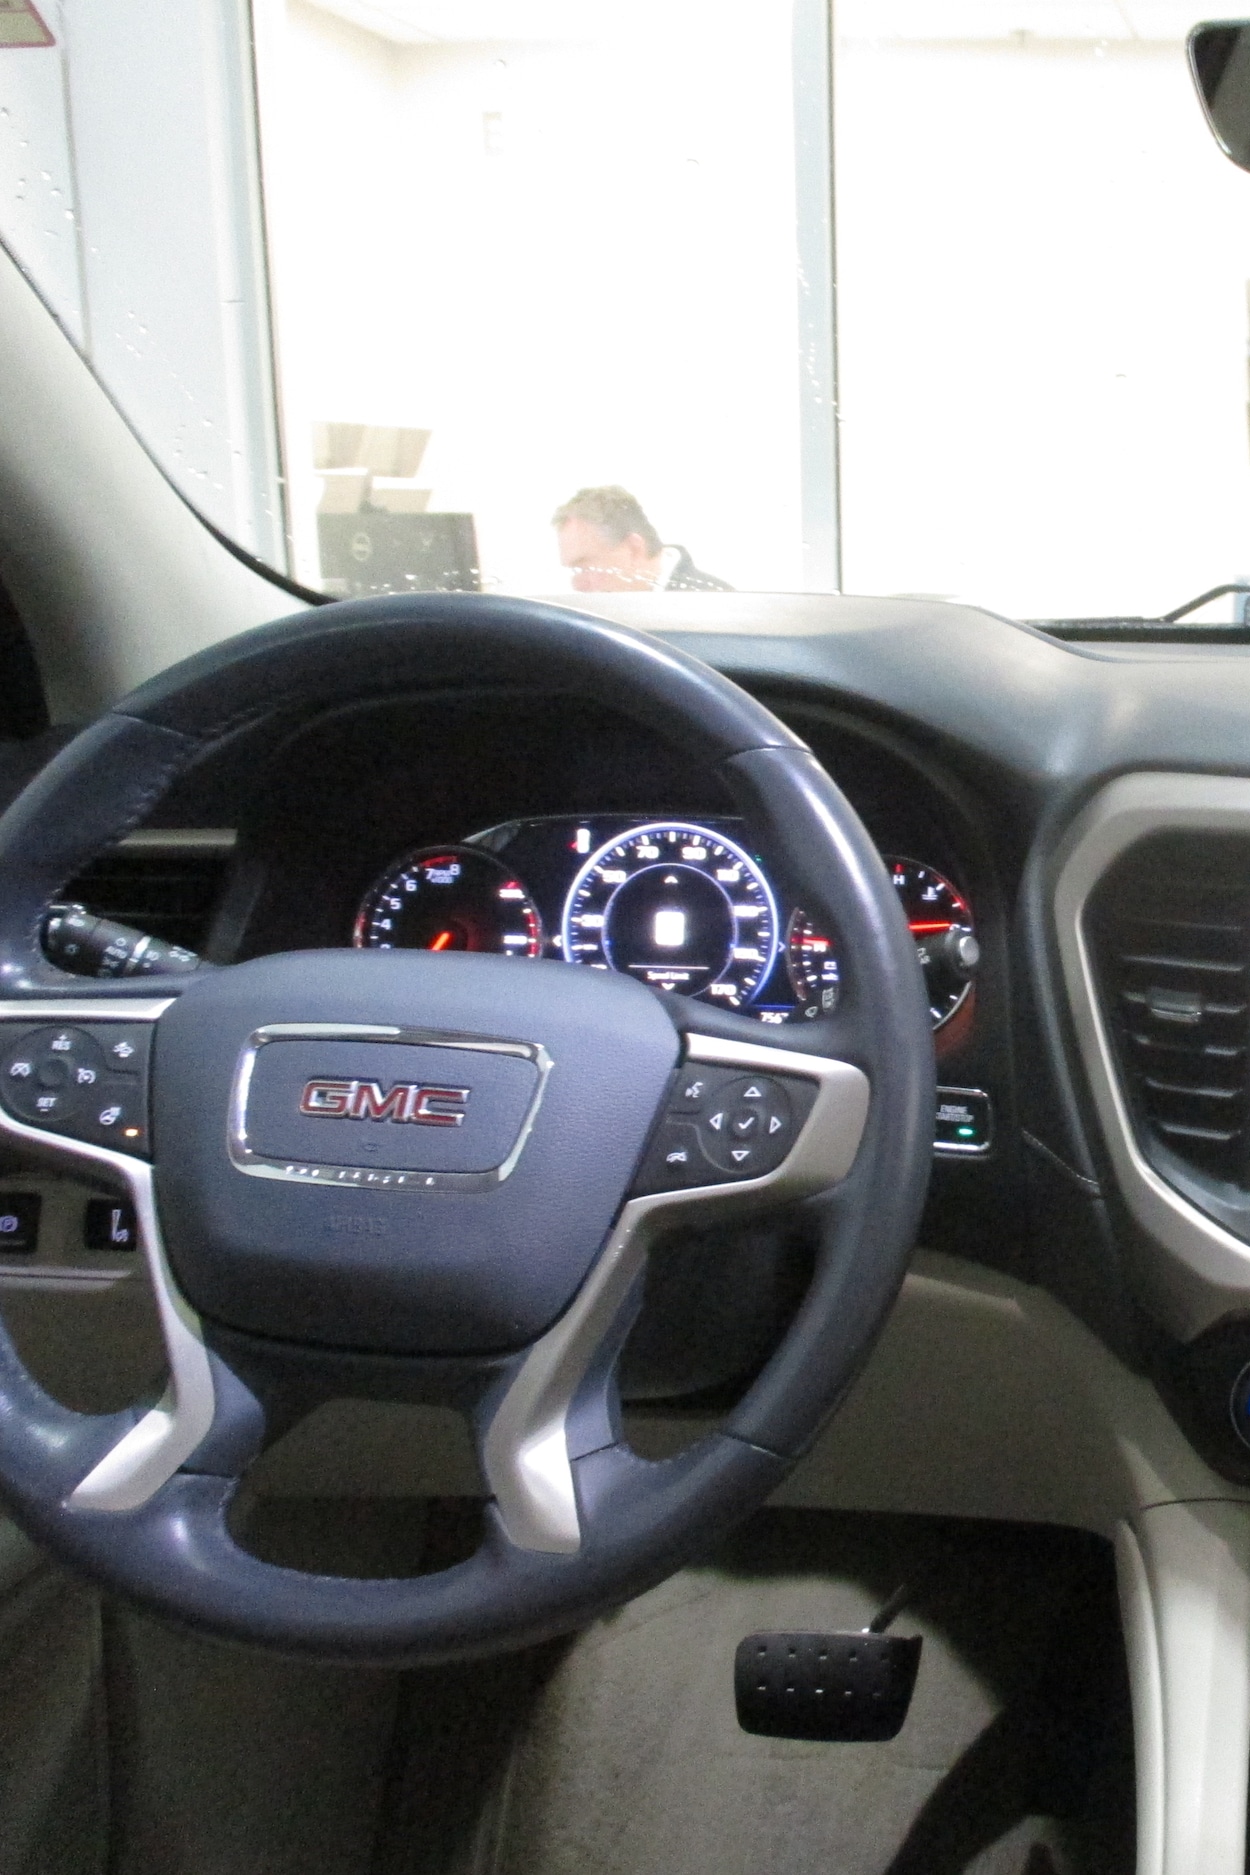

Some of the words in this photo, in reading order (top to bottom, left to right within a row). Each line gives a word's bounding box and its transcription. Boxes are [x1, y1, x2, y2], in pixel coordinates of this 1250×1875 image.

[636, 845, 660, 859] 70
[424, 868, 435, 880] 7
[449, 863, 461, 877] 8
[405, 880, 417, 892] 6
[390, 898, 402, 910] 5
[380, 918, 392, 931] 4
[300, 1078, 471, 1127] GMC
